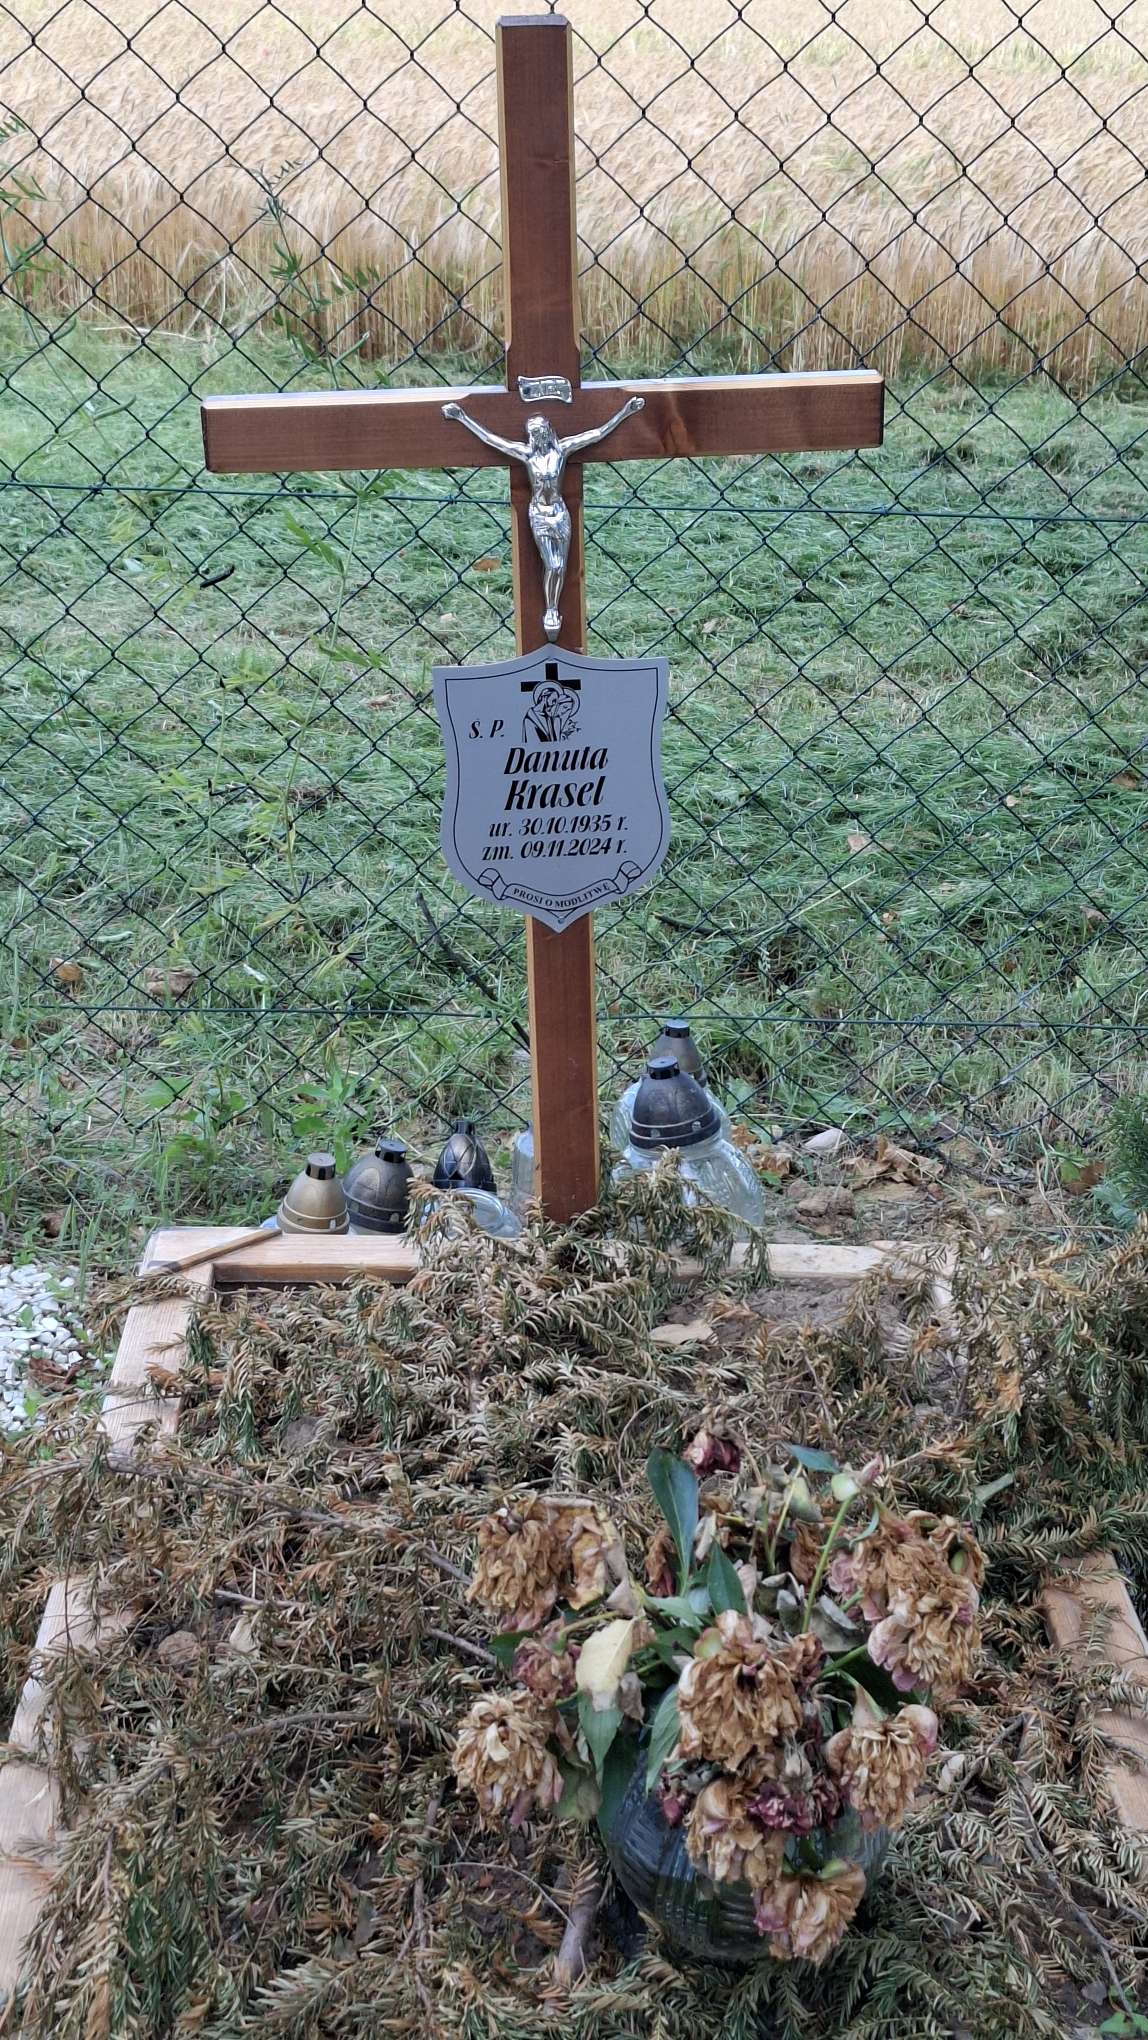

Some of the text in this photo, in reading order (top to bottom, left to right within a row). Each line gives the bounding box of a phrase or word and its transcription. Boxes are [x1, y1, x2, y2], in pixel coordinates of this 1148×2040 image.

[489, 719, 505, 738] P.
[503, 745, 609, 775] Danuta
[503, 775, 607, 811] Krasel
[489, 814, 629, 838] ur. 30.10.1935 r.
[481, 837, 628, 861] zm. 09.11.2024 r.
[513, 888, 544, 905] PROSI
[545, 898, 553, 907] O
